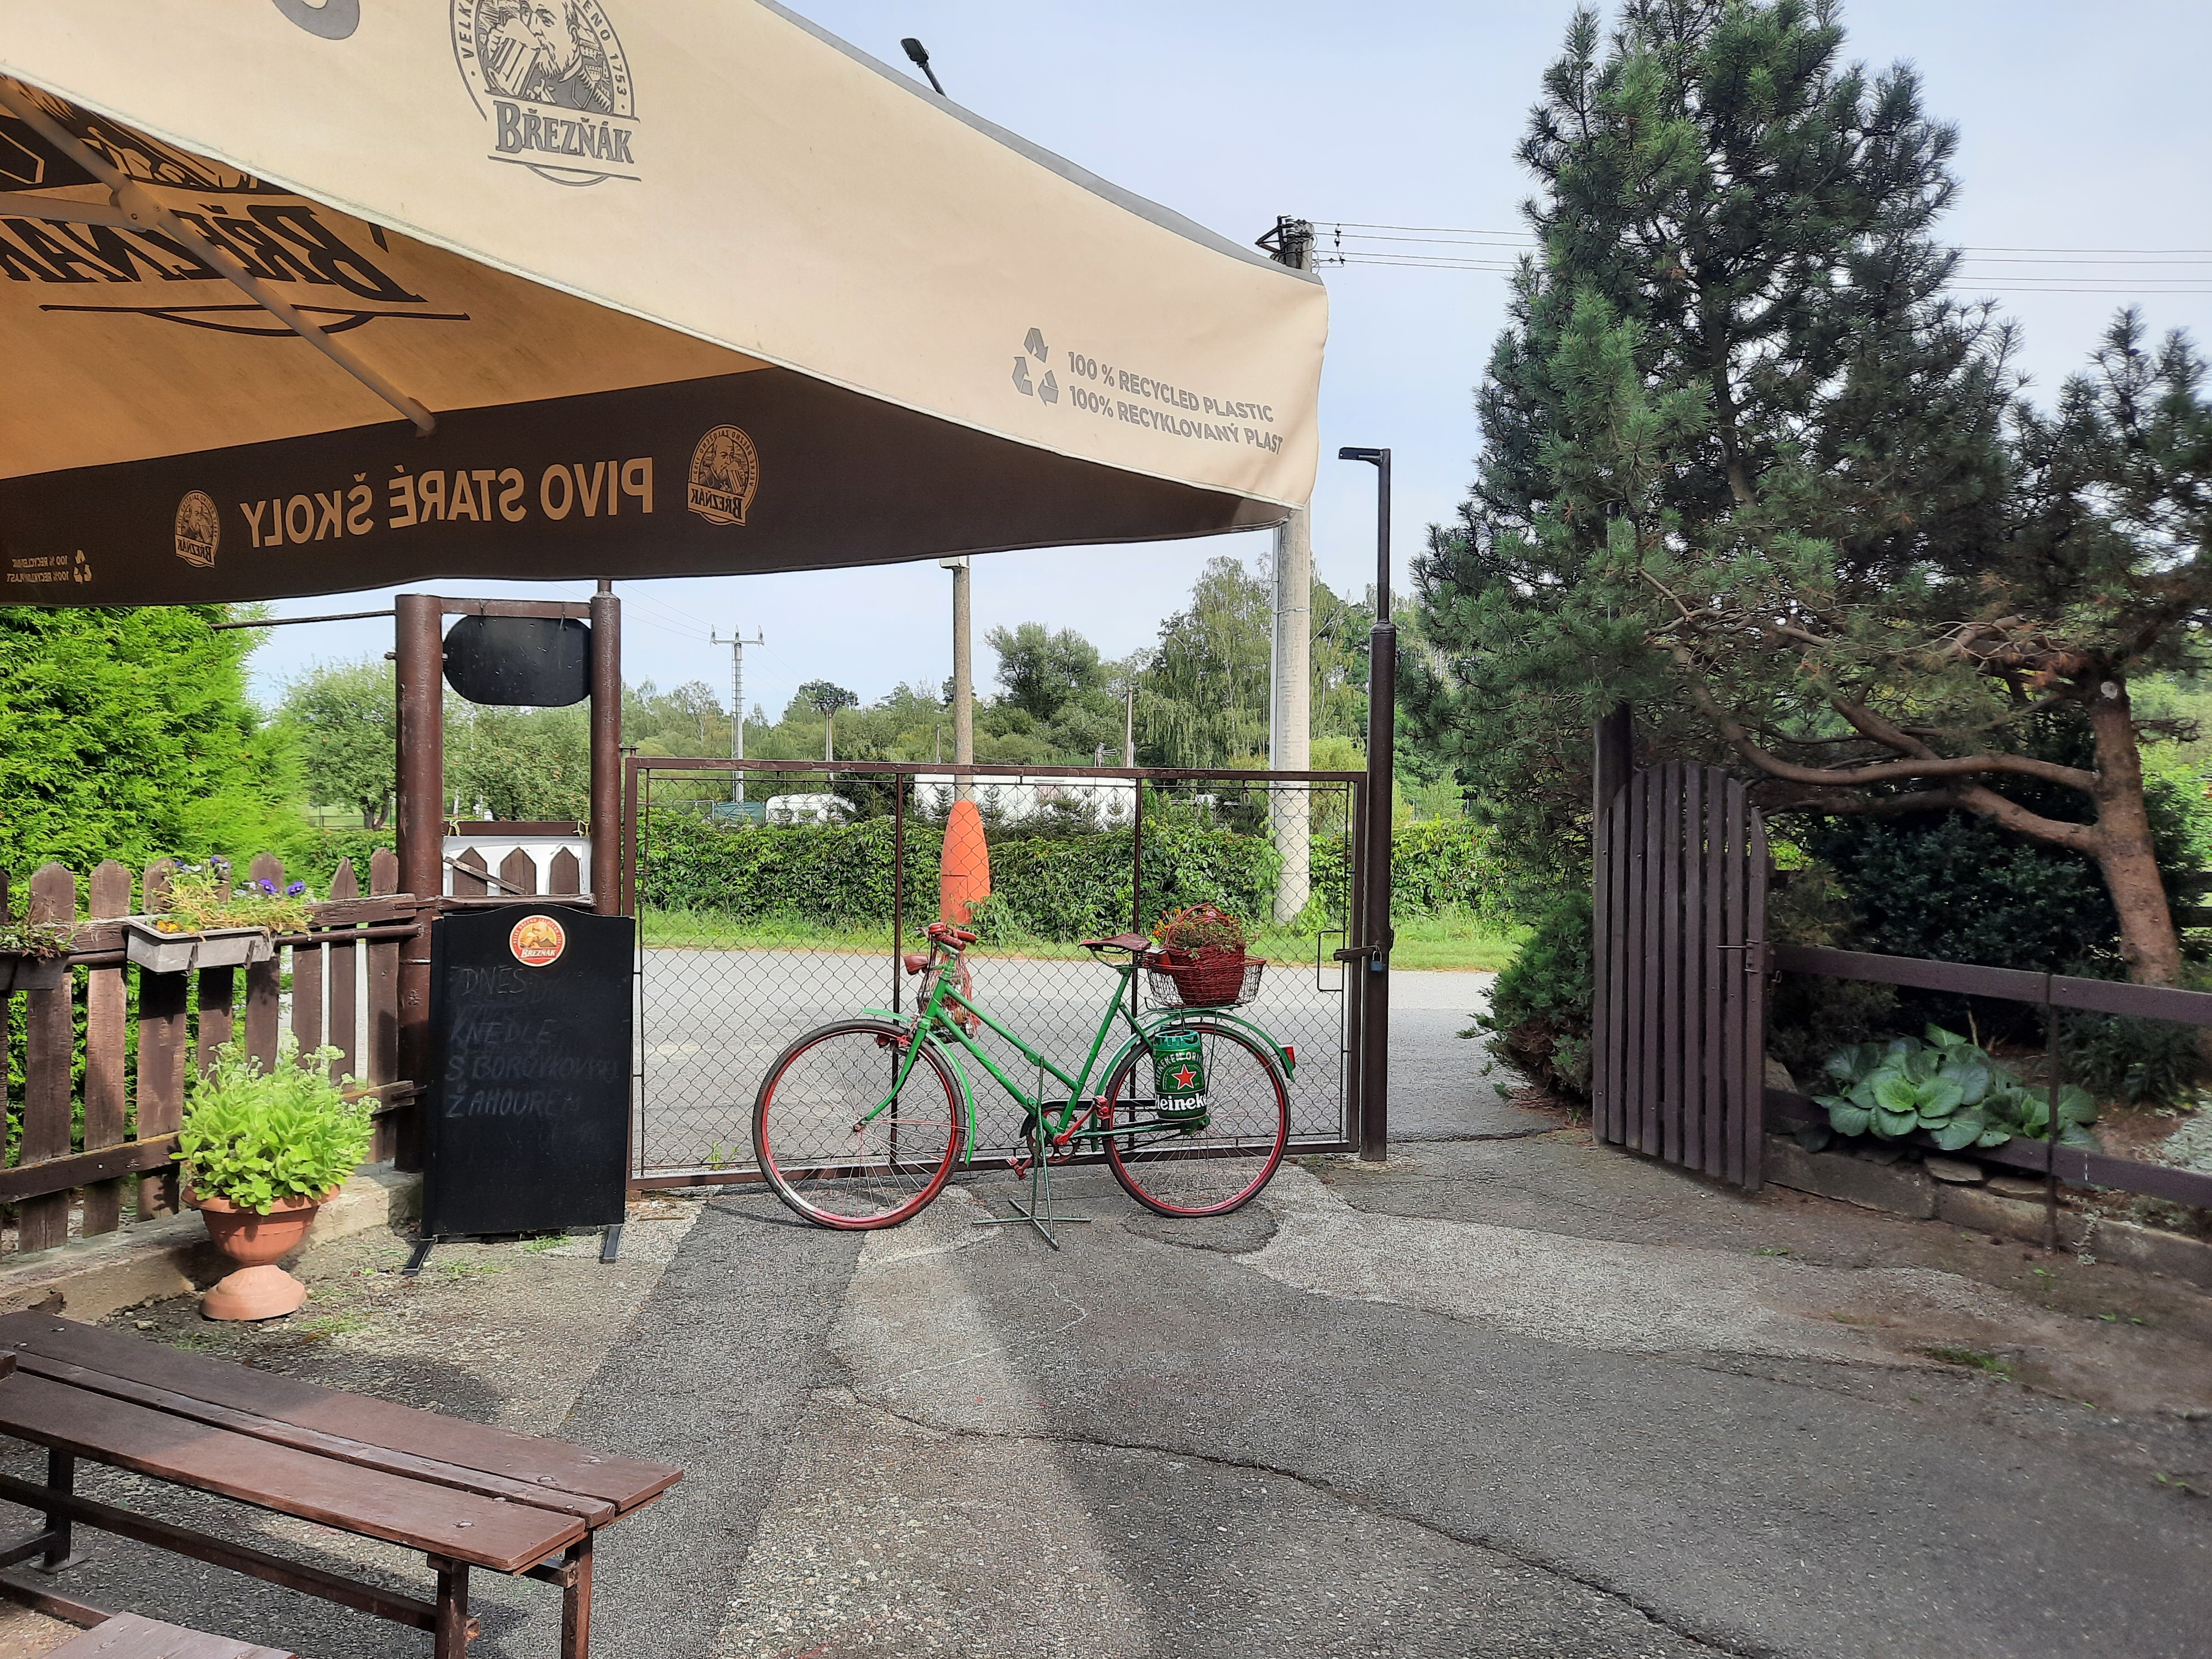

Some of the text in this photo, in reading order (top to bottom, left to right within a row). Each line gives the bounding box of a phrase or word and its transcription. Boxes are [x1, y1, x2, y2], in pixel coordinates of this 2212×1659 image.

[458, 0, 474, 59] VELK
[609, 53, 627, 96] 1753
[494, 100, 634, 164] BŘEZŇÁK
[1067, 351, 1274, 422] 100 % RECYCLED PLASTIC
[1069, 385, 1284, 455] 100% RECYKLOVANÝ PLAST
